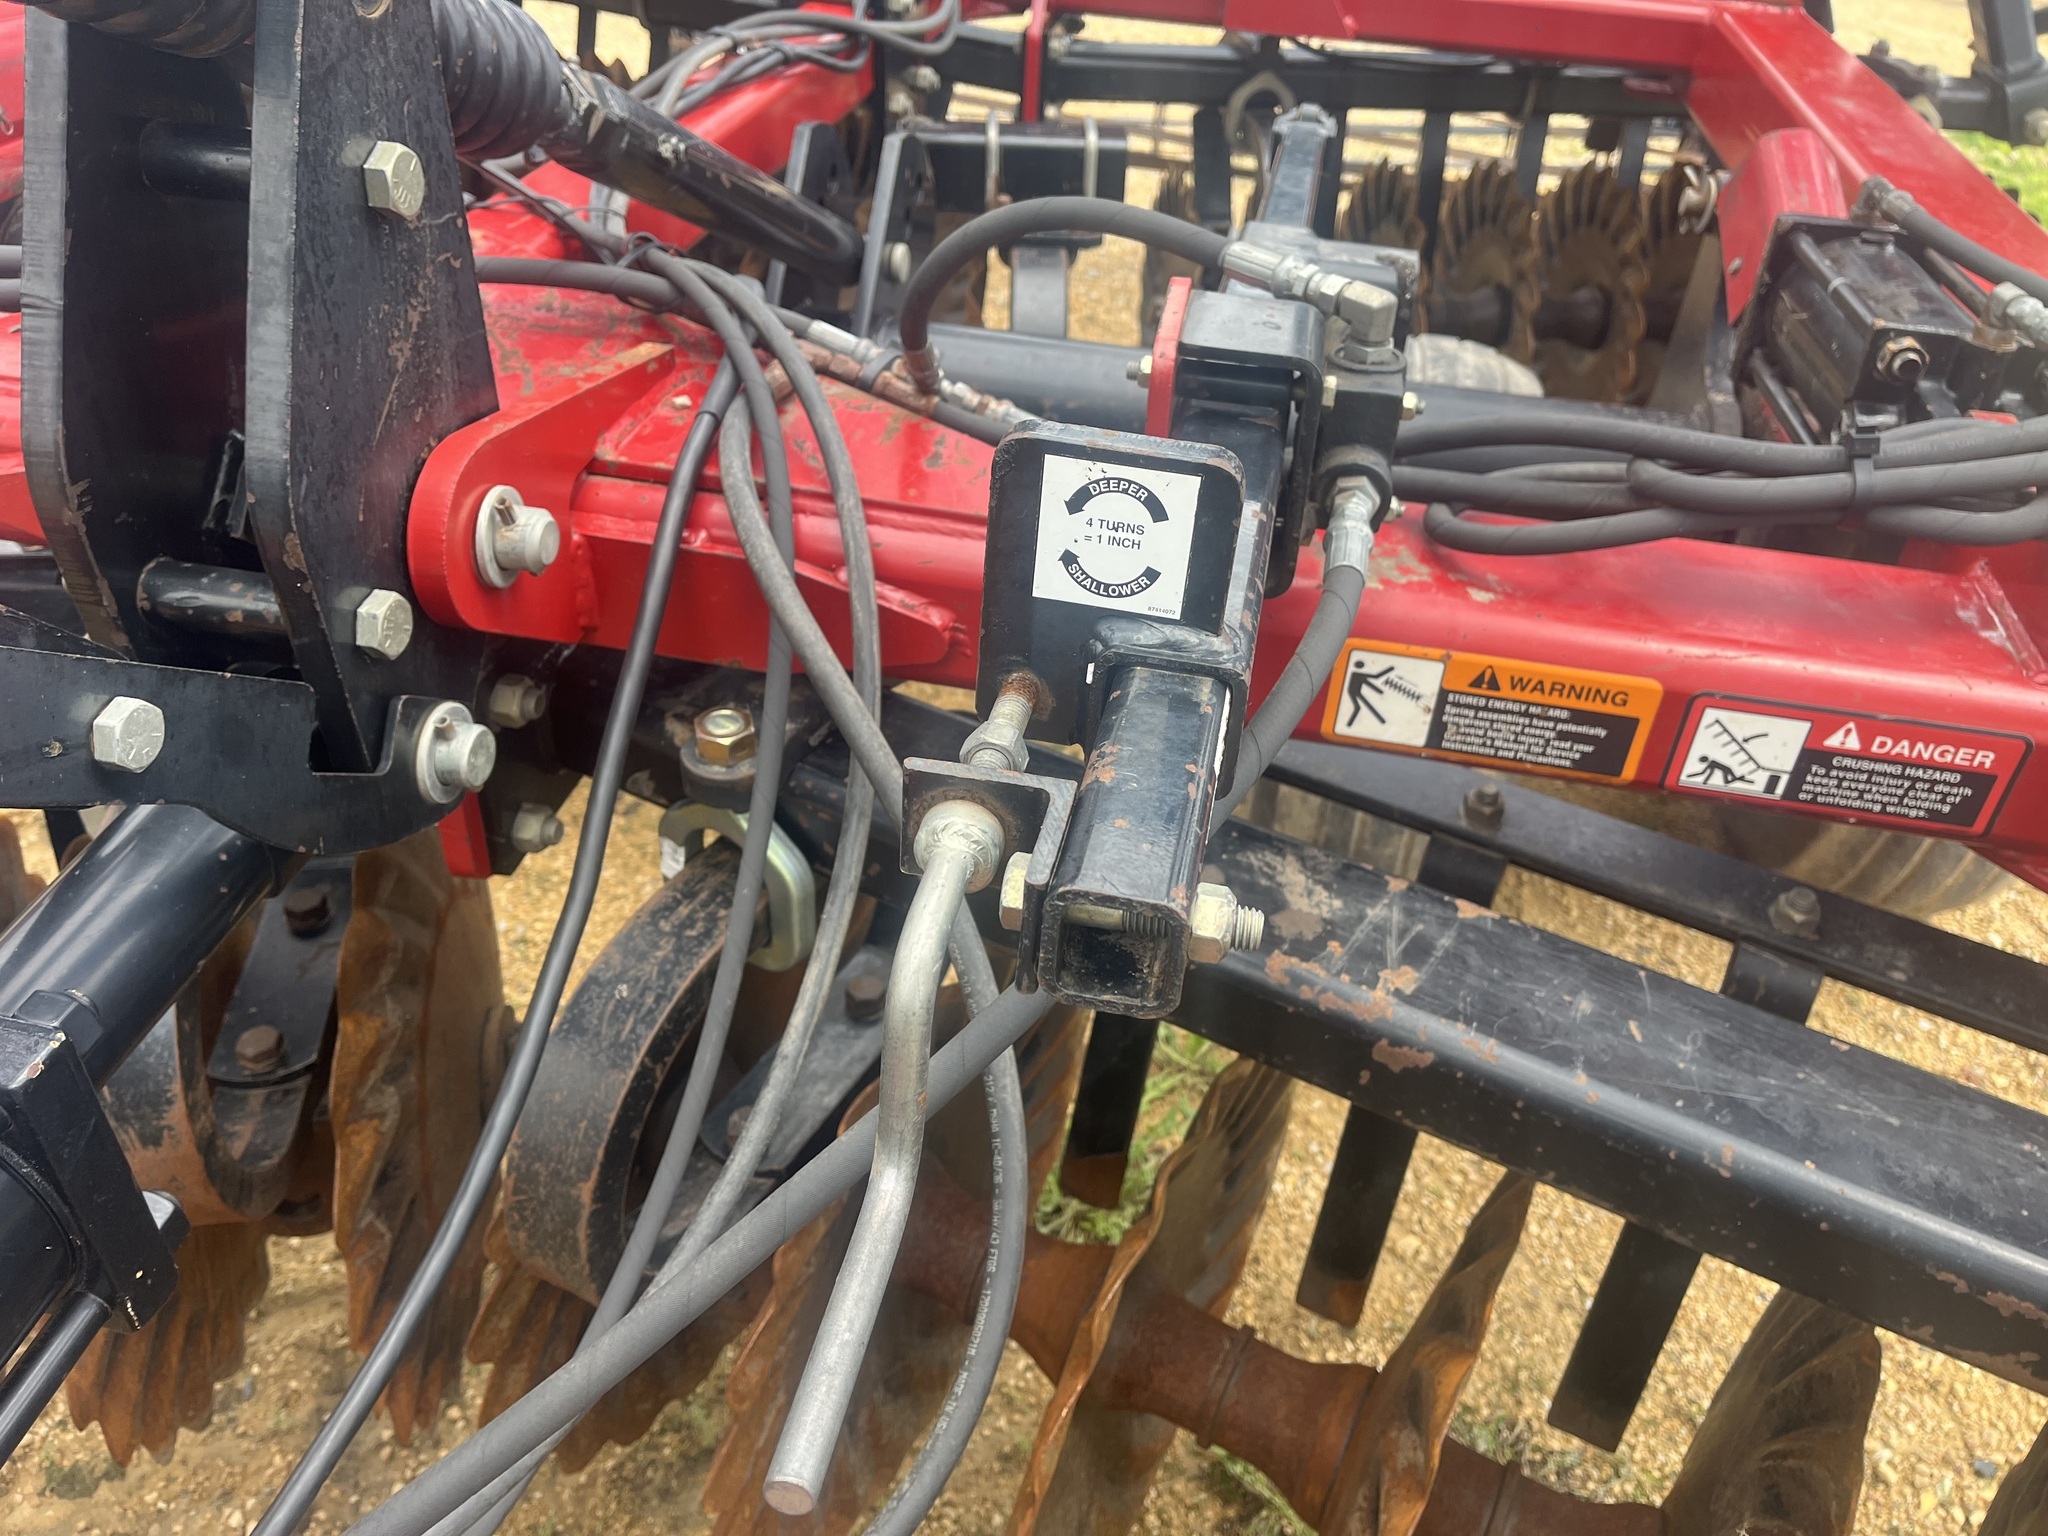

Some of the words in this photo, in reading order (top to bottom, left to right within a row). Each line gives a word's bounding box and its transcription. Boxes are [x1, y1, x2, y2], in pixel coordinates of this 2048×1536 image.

[1088, 479, 1149, 502] DEEPER
[1086, 518, 1093, 527] 4
[1098, 518, 1145, 536] TURNS
[1097, 534, 1102, 544] 1
[1107, 535, 1141, 550] INCH
[1068, 563, 1151, 597] SHALLOWER
[1447, 692, 1486, 707] STORED
[1488, 698, 1528, 714] ENERGY
[1529, 704, 1571, 720] HAARD:
[1509, 675, 1630, 708] WARNING
[1442, 713, 1490, 729] dangerous
[1444, 703, 1475, 718] Spring
[1477, 709, 1530, 726] assemblies
[1532, 716, 1555, 729] have
[1556, 721, 1608, 739] potentially
[1441, 739, 1496, 757] Instructions
[1497, 747, 1515, 759] and
[1459, 725, 1485, 737] avoid
[1550, 738, 1572, 750] read
[1573, 743, 1596, 755] your
[1494, 738, 1529, 752] Manual
[1530, 743, 1544, 754] for
[1545, 745, 1582, 760] Service
[1870, 735, 1996, 770] DANGER
[1810, 764, 1826, 776] To
[1829, 767, 1868, 782] avoid
[1871, 773, 1912, 790] injury
[1915, 780, 1931, 791] or
[1933, 782, 1973, 798] death
[1832, 755, 1903, 776] CRUSHING
[1904, 765, 1962, 784] HAZARD
[1801, 783, 1859, 800] machine
[1863, 791, 1899, 805] when
[1902, 796, 1952, 815] folding
[1805, 773, 1838, 788] keep
[1841, 779, 1905, 797] everyone
[1908, 788, 1943, 802] clear
[1945, 794, 1962, 805] of
[1797, 791, 1815, 801] or
[1816, 793, 1882, 814] unfolding
[1885, 803, 1930, 819] wings.
